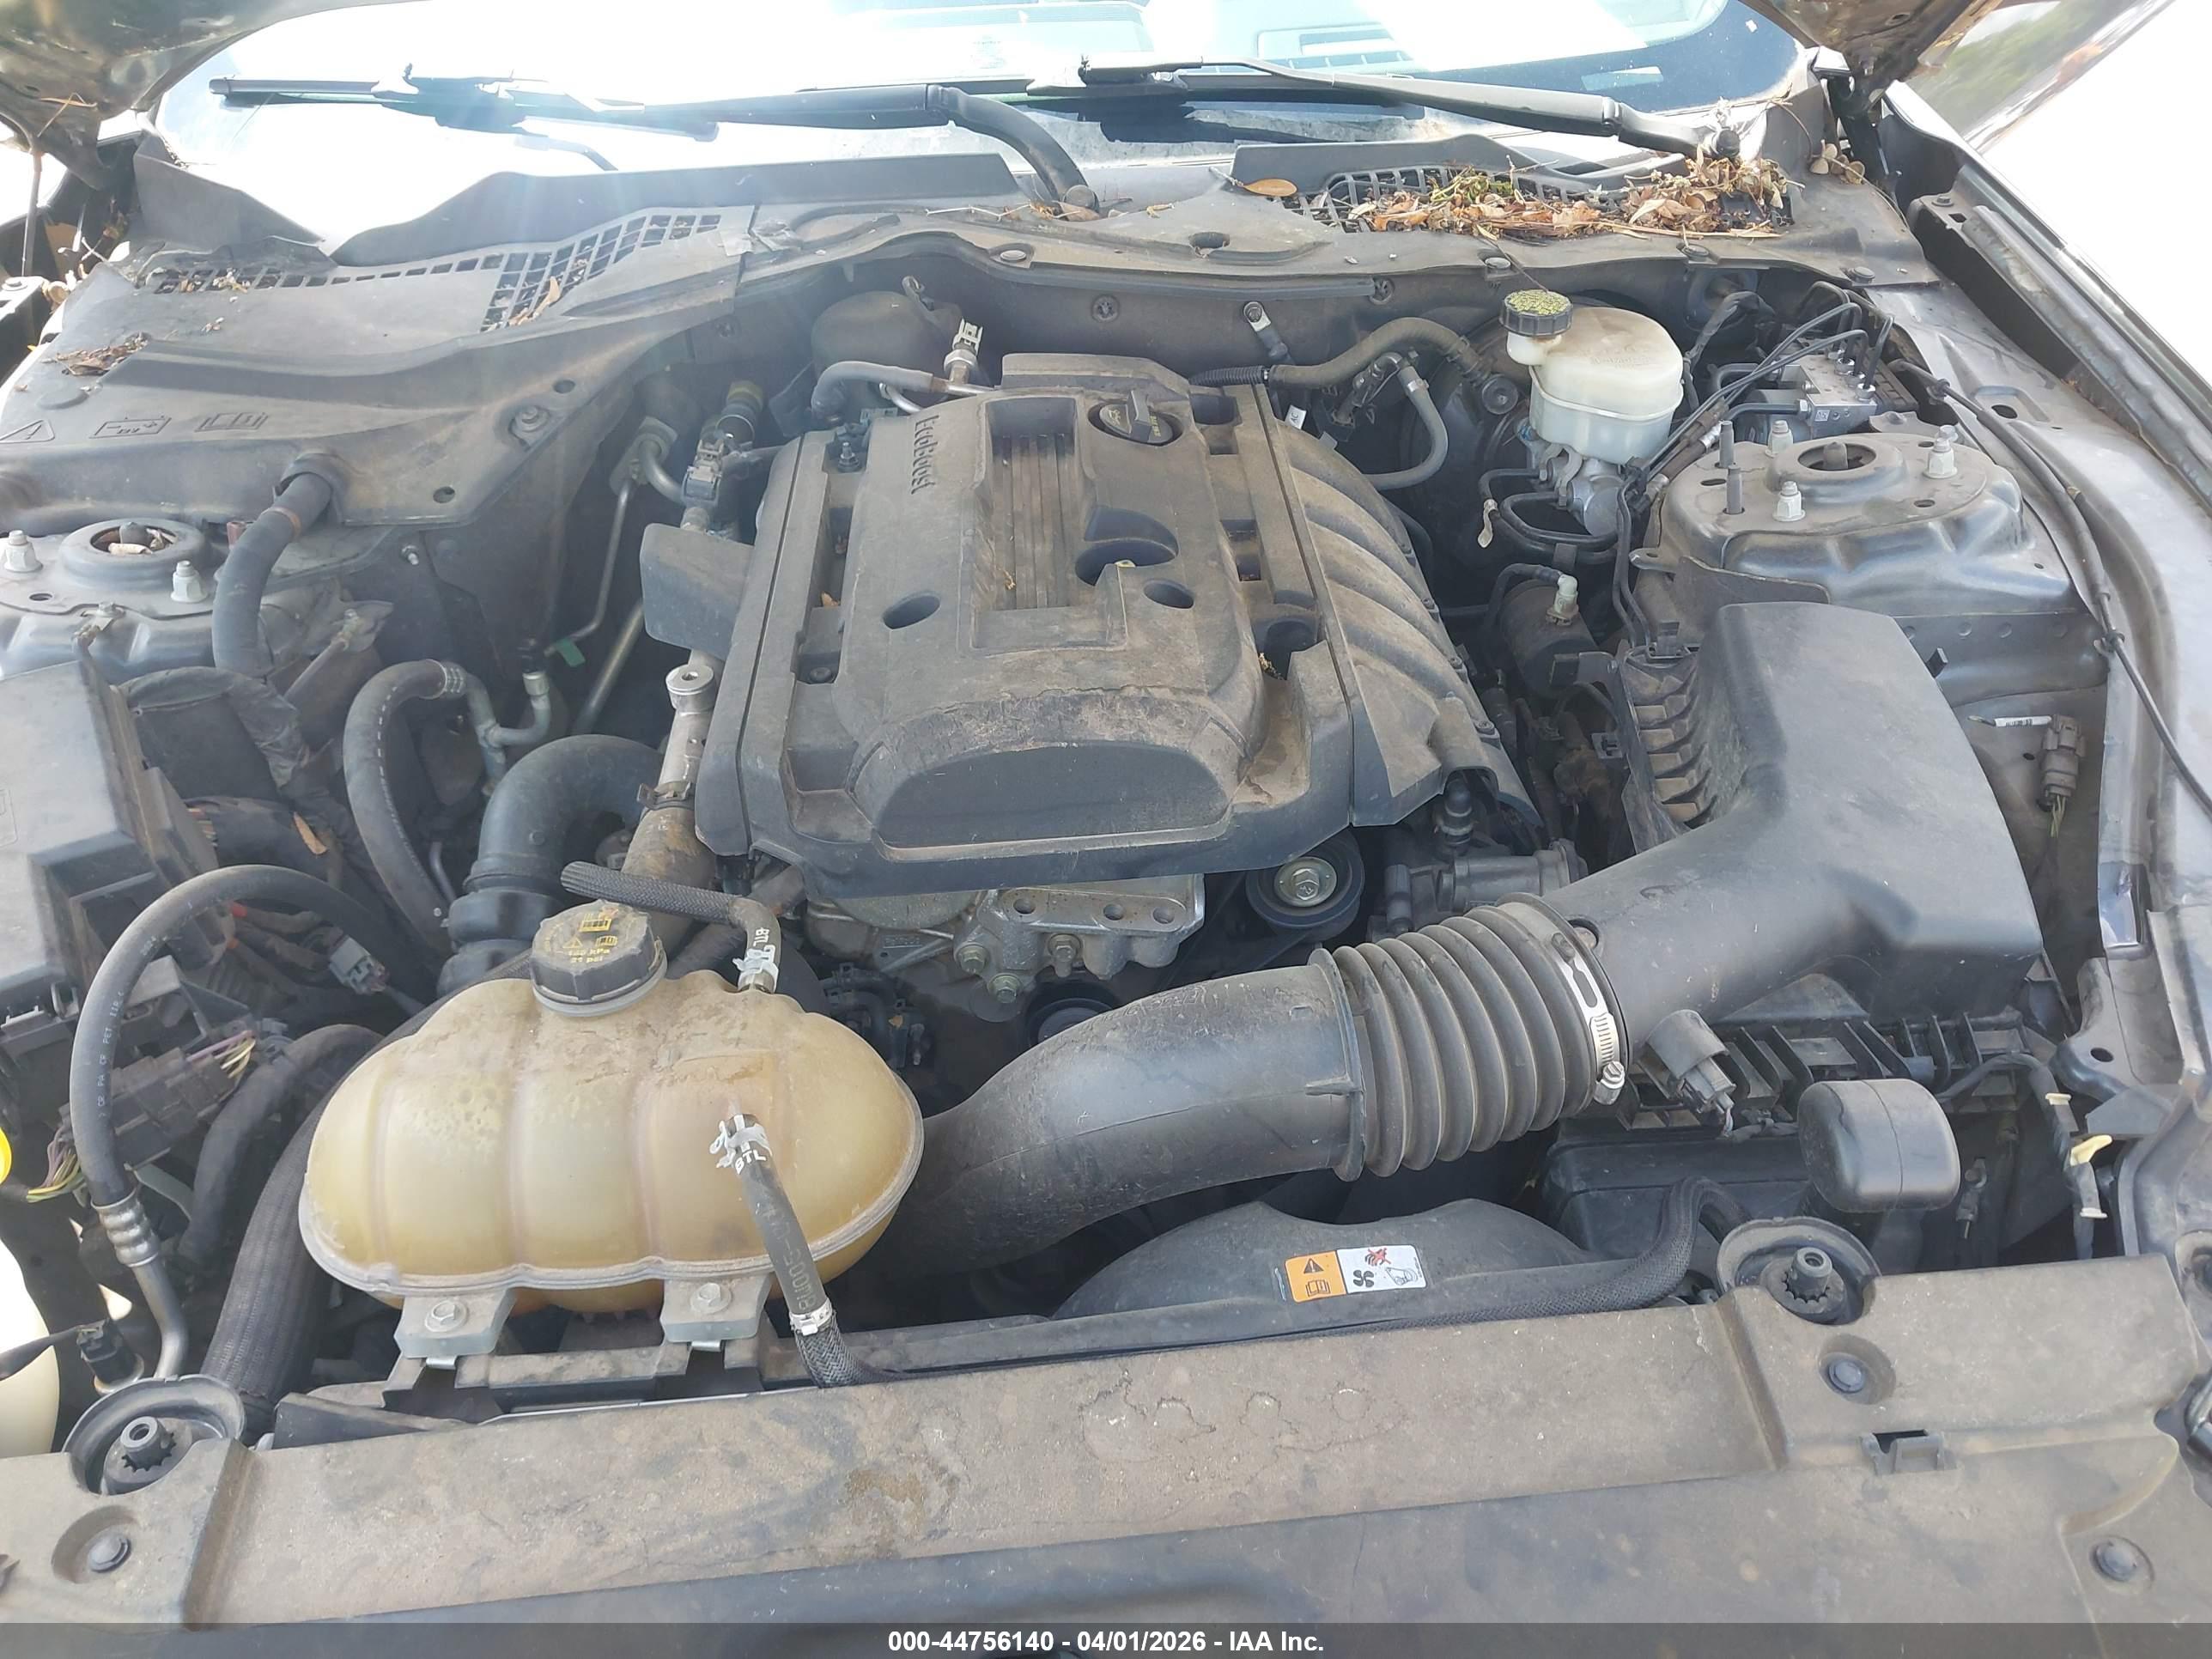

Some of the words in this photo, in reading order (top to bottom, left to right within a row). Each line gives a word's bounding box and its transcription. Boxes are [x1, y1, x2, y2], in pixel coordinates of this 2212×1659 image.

[910, 415, 940, 495] EcoBoost
[753, 927, 770, 947] BTL
[735, 1149, 767, 1175] BTL
